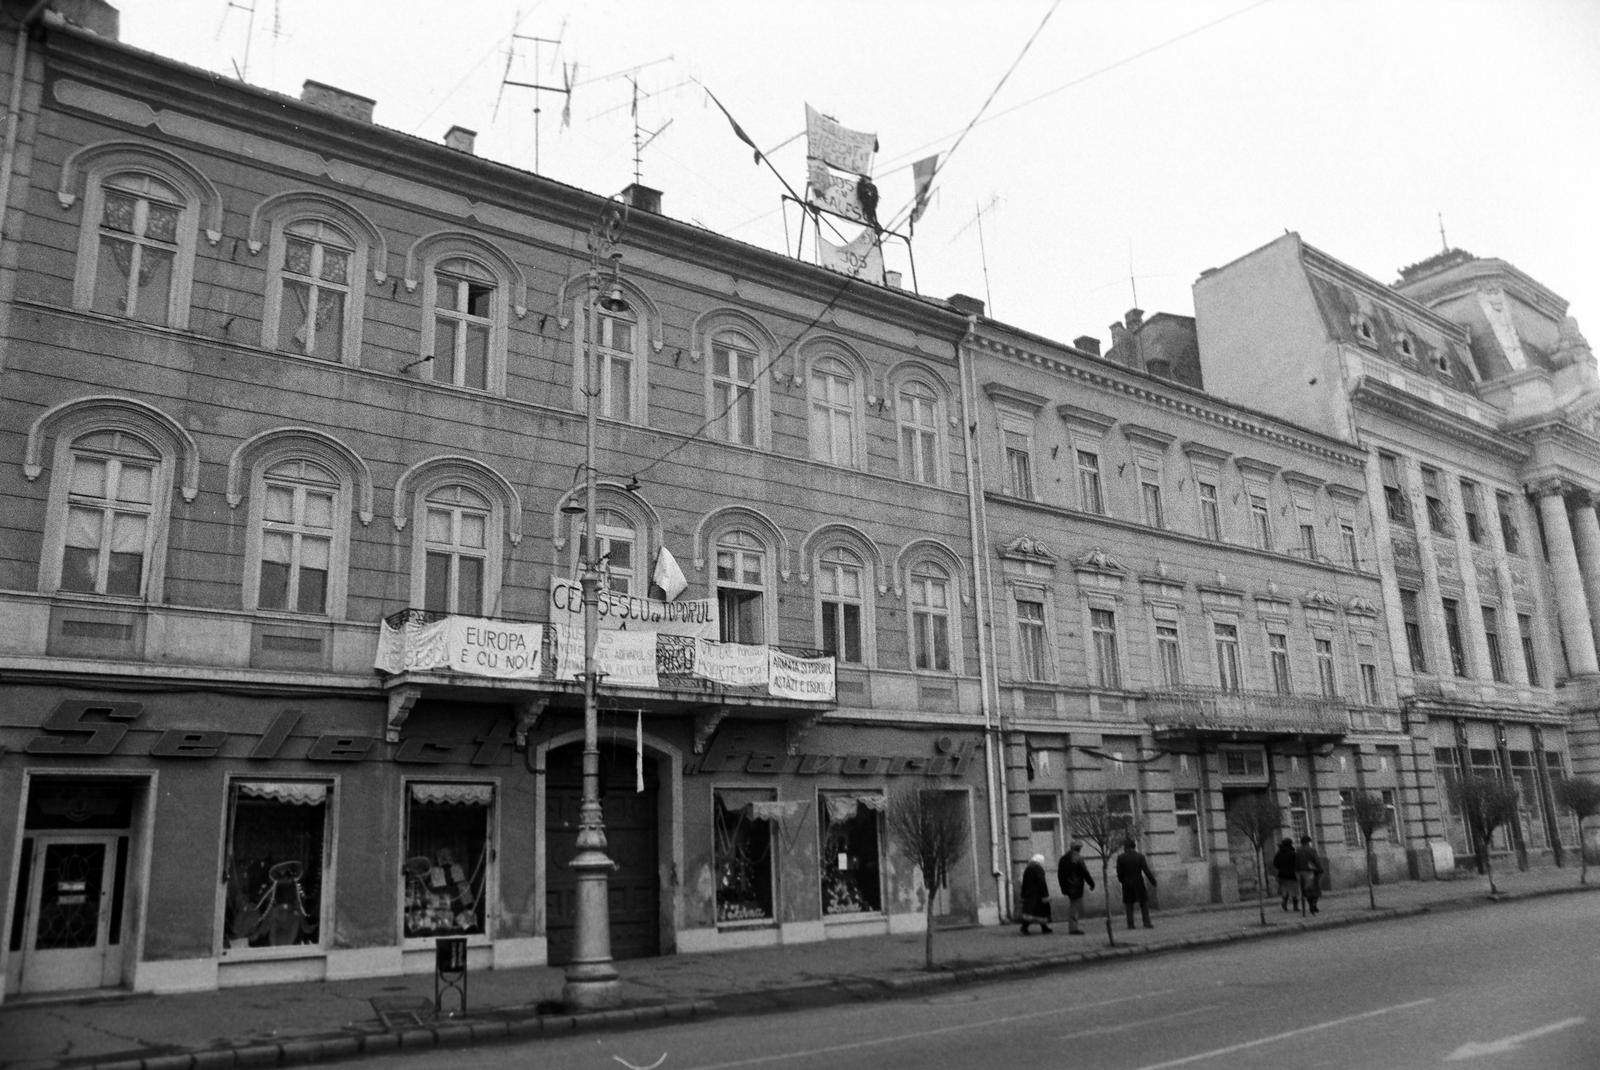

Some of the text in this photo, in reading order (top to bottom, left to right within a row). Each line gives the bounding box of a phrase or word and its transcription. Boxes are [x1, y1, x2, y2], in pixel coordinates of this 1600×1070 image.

[466, 626, 526, 651] EUROPA
[460, 648, 469, 664] E
[476, 650, 497, 669] CU
[25, 700, 514, 764] Select
